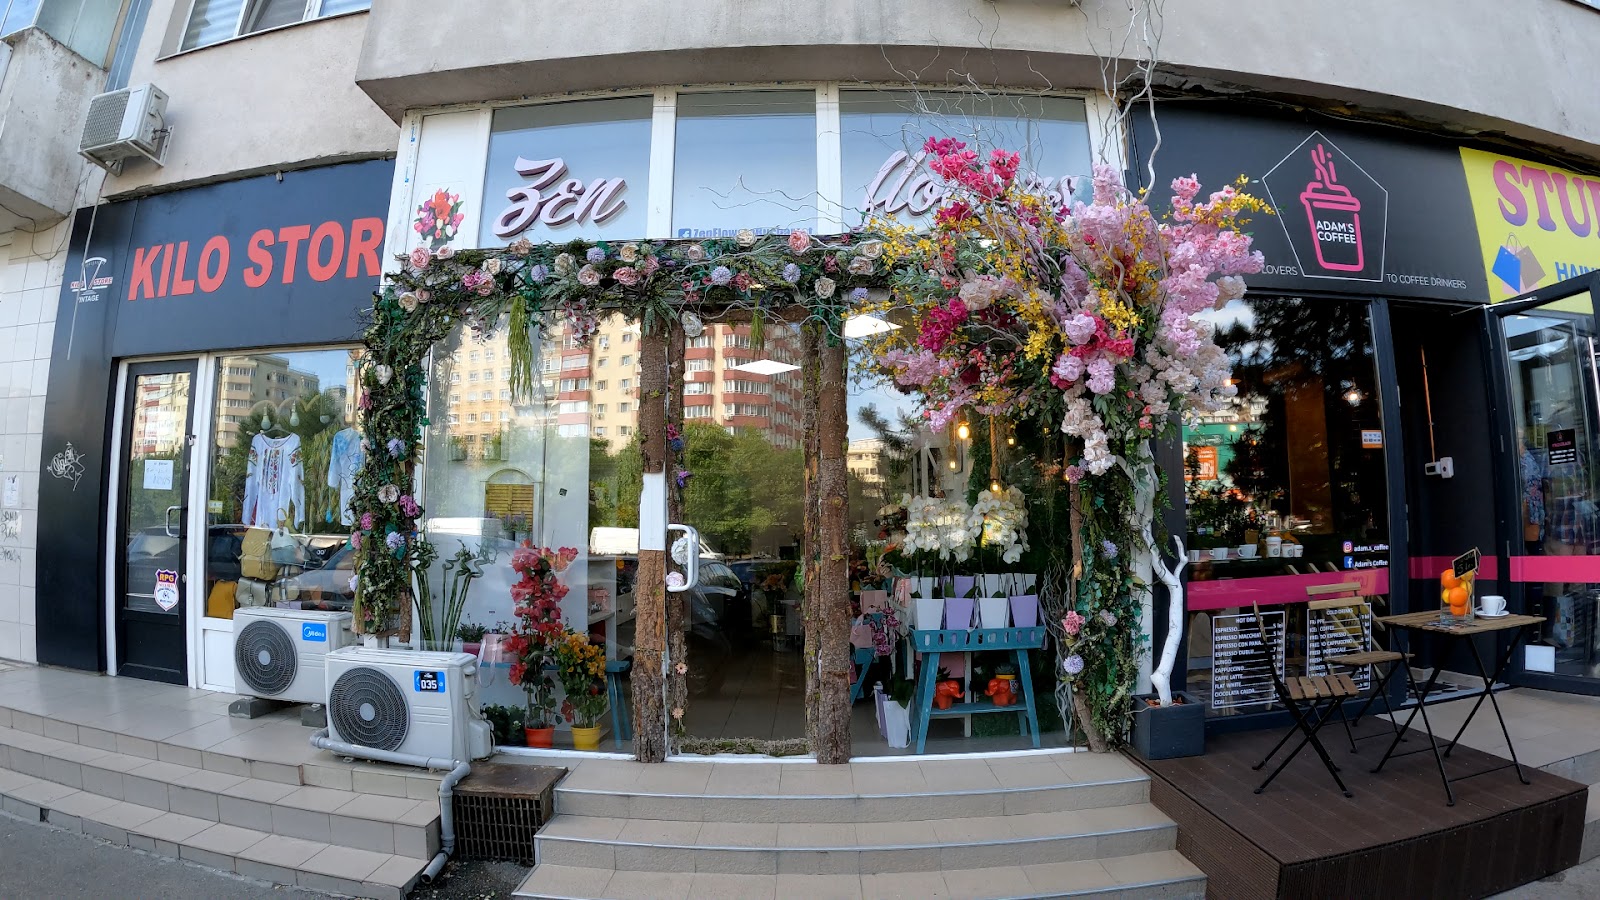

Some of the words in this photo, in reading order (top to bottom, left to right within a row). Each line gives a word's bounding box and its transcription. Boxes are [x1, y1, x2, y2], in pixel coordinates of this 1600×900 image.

[492, 155, 627, 238] Zen
[1493, 160, 1600, 238] STU
[1316, 220, 1355, 233] ADAM'S
[1317, 231, 1357, 244] COFFEE
[128, 235, 230, 301] KILO
[243, 217, 384, 288] STOR
[93, 276, 113, 286] STORE
[1262, 264, 1298, 276] LOVERS
[1386, 273, 1398, 284] TO
[1400, 274, 1430, 286] COFFEE
[1430, 276, 1467, 290] DRINKERS
[159, 573, 175, 582] RPG
[1215, 665, 1245, 673] CAPPUCCINO
[421, 679, 437, 690] 035
